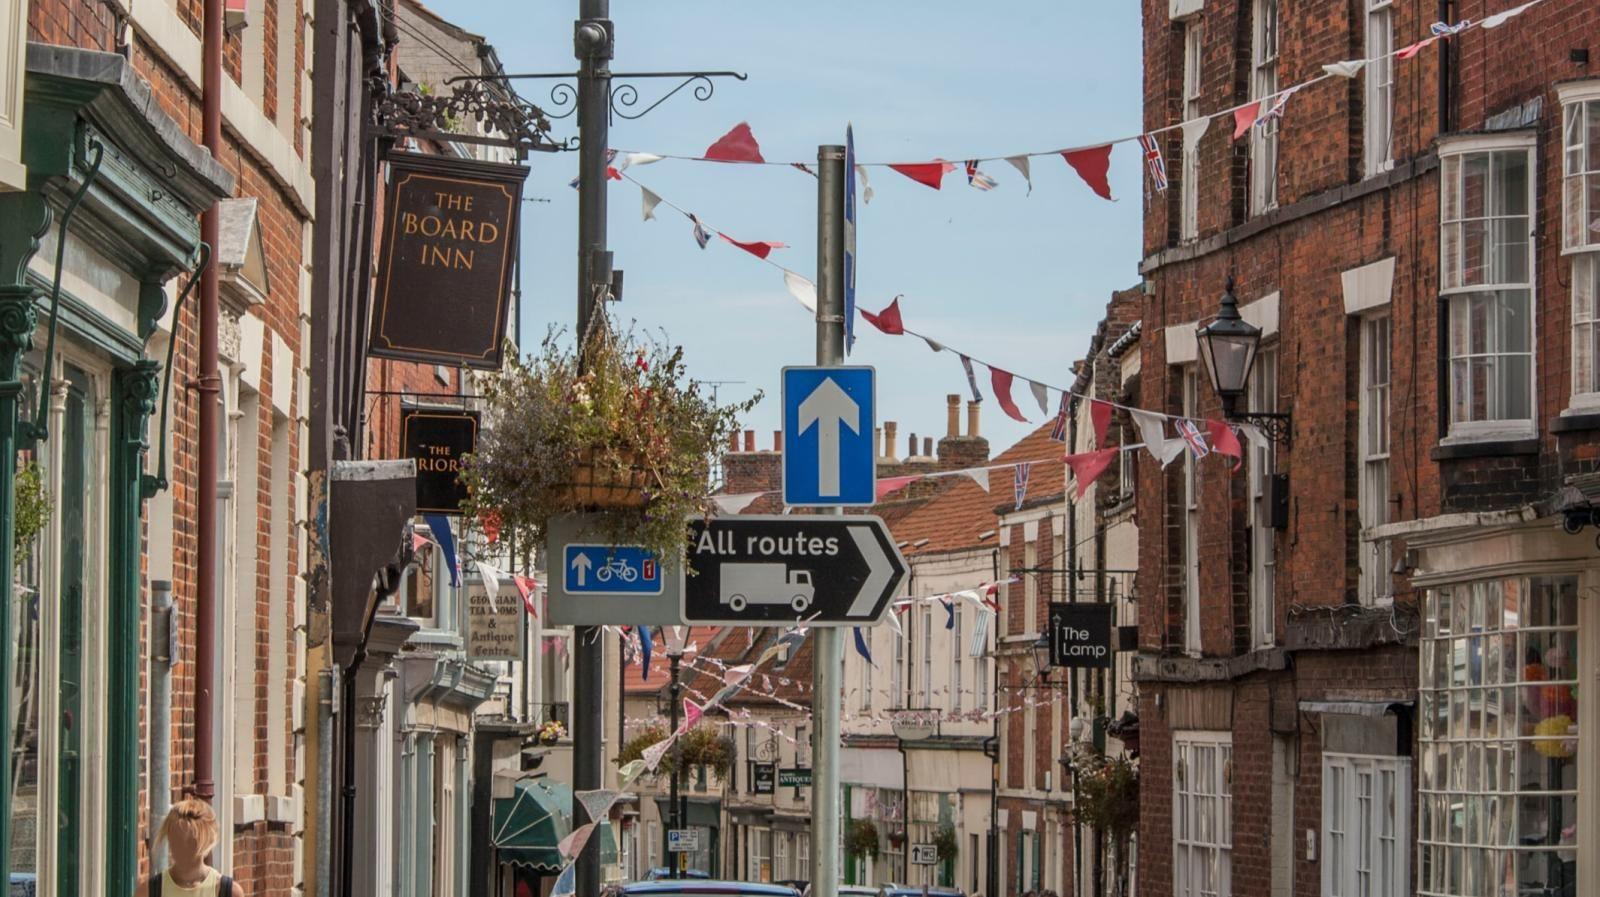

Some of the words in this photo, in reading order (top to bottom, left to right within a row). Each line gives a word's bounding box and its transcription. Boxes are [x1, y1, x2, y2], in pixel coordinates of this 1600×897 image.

[435, 192, 474, 212] THE
[405, 213, 498, 243] BOARD
[421, 244, 474, 270] INN
[429, 446, 451, 456] THE
[418, 458, 459, 472] RIOR
[696, 530, 737, 555] All
[747, 532, 839, 556] routes
[470, 595, 517, 605] GEOGIAN
[470, 606, 486, 616] TEA
[488, 618, 497, 629] &
[472, 631, 514, 645] Antique
[1062, 626, 1090, 641] The
[475, 645, 510, 657] Centre
[1063, 642, 1107, 659] Lamp
[780, 776, 812, 785] ANTIQUE
